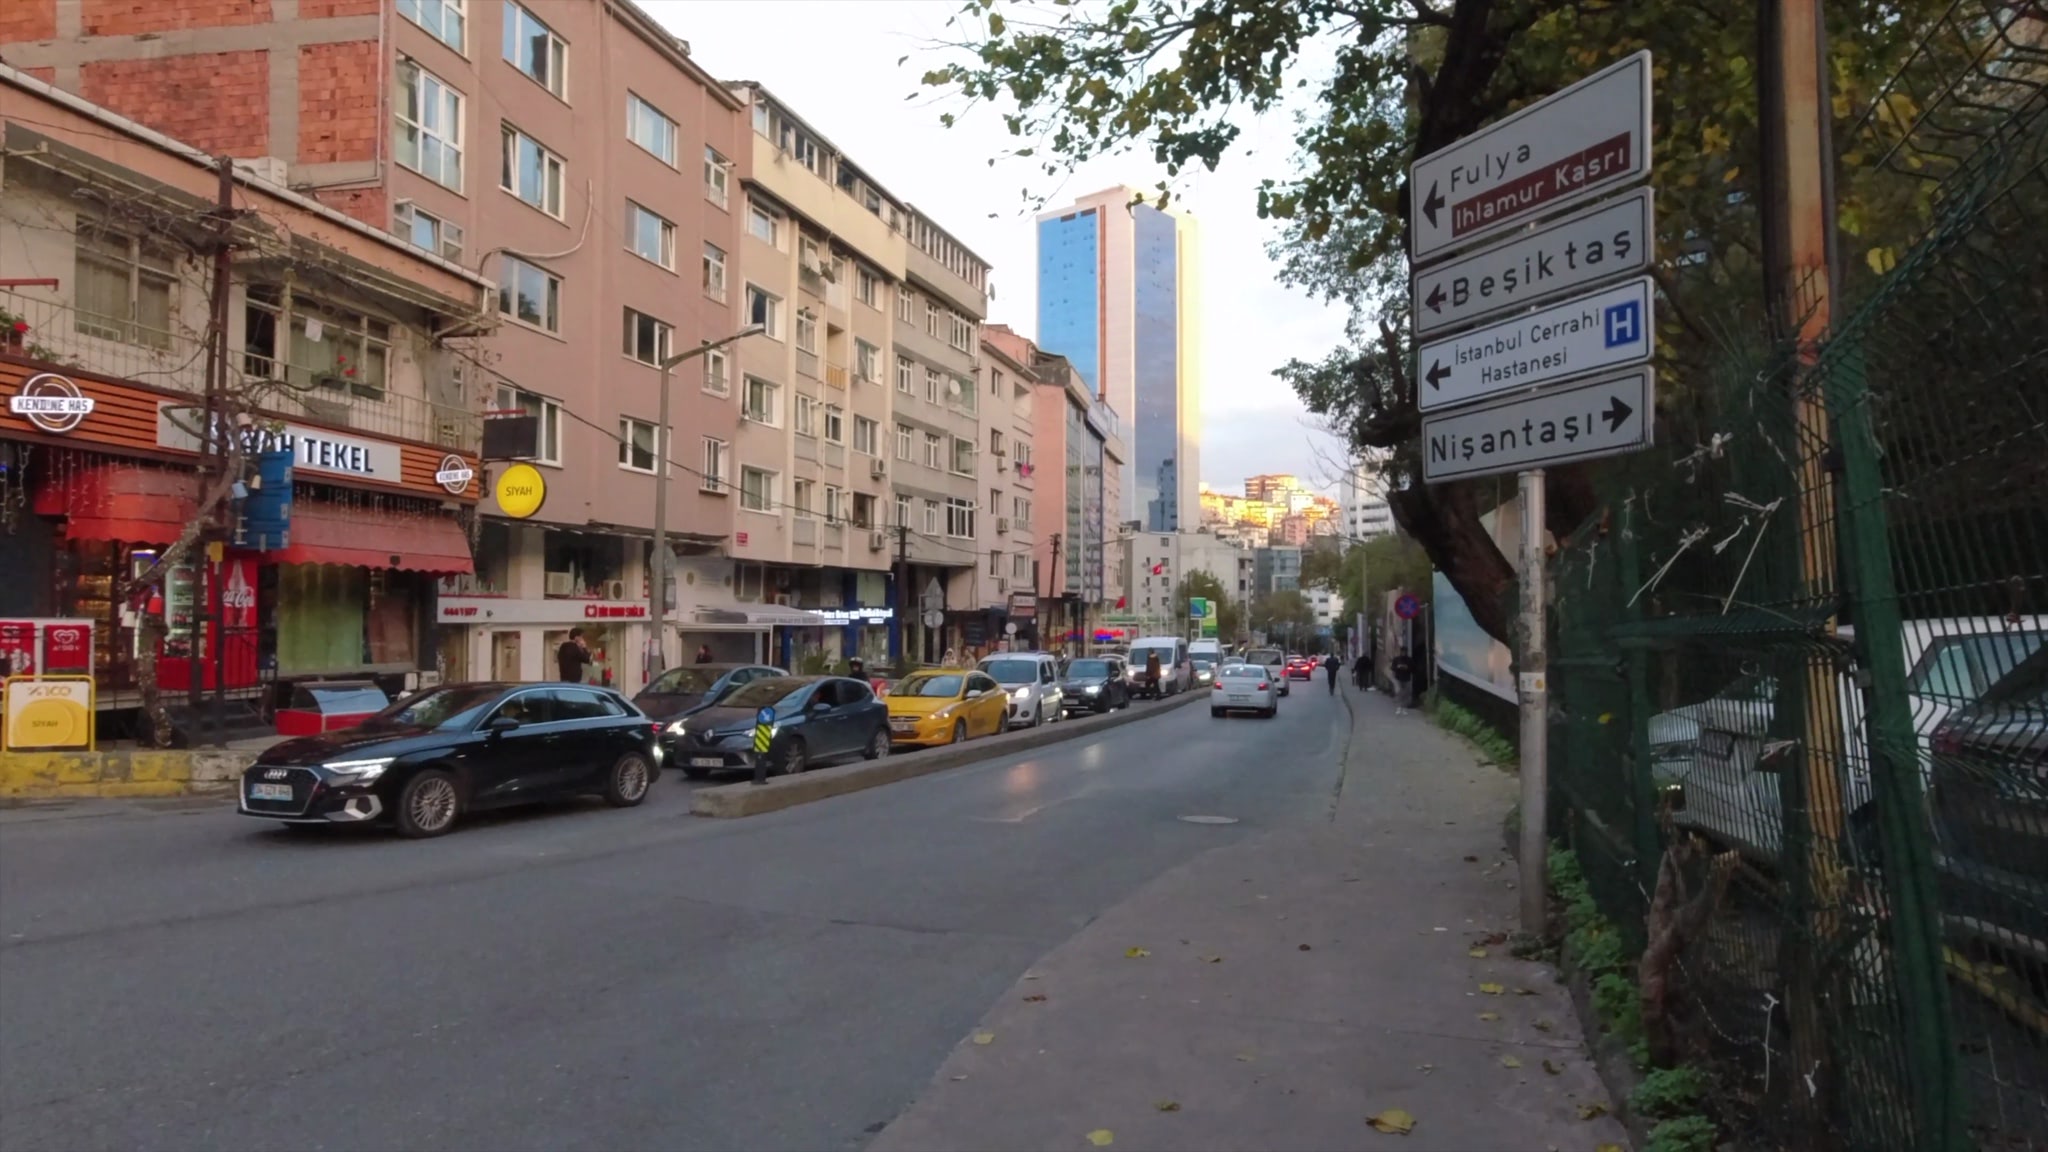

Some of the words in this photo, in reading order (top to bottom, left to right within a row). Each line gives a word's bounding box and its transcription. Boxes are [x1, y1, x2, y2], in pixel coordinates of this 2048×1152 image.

[1451, 144, 1531, 192] Fulya
[1456, 181, 1545, 230] Ihlamur
[1555, 148, 1624, 190] Kasrı
[1452, 230, 1632, 308] Beşiktaş
[1454, 330, 1522, 366] İstanbul
[1531, 308, 1600, 345] Cerrahi
[1612, 307, 1633, 339] H
[1481, 347, 1568, 384] Hastanesi
[68, 400, 88, 411] HAS
[302, 437, 374, 473] TEKEL
[1431, 413, 1594, 464] Nişantaşı
